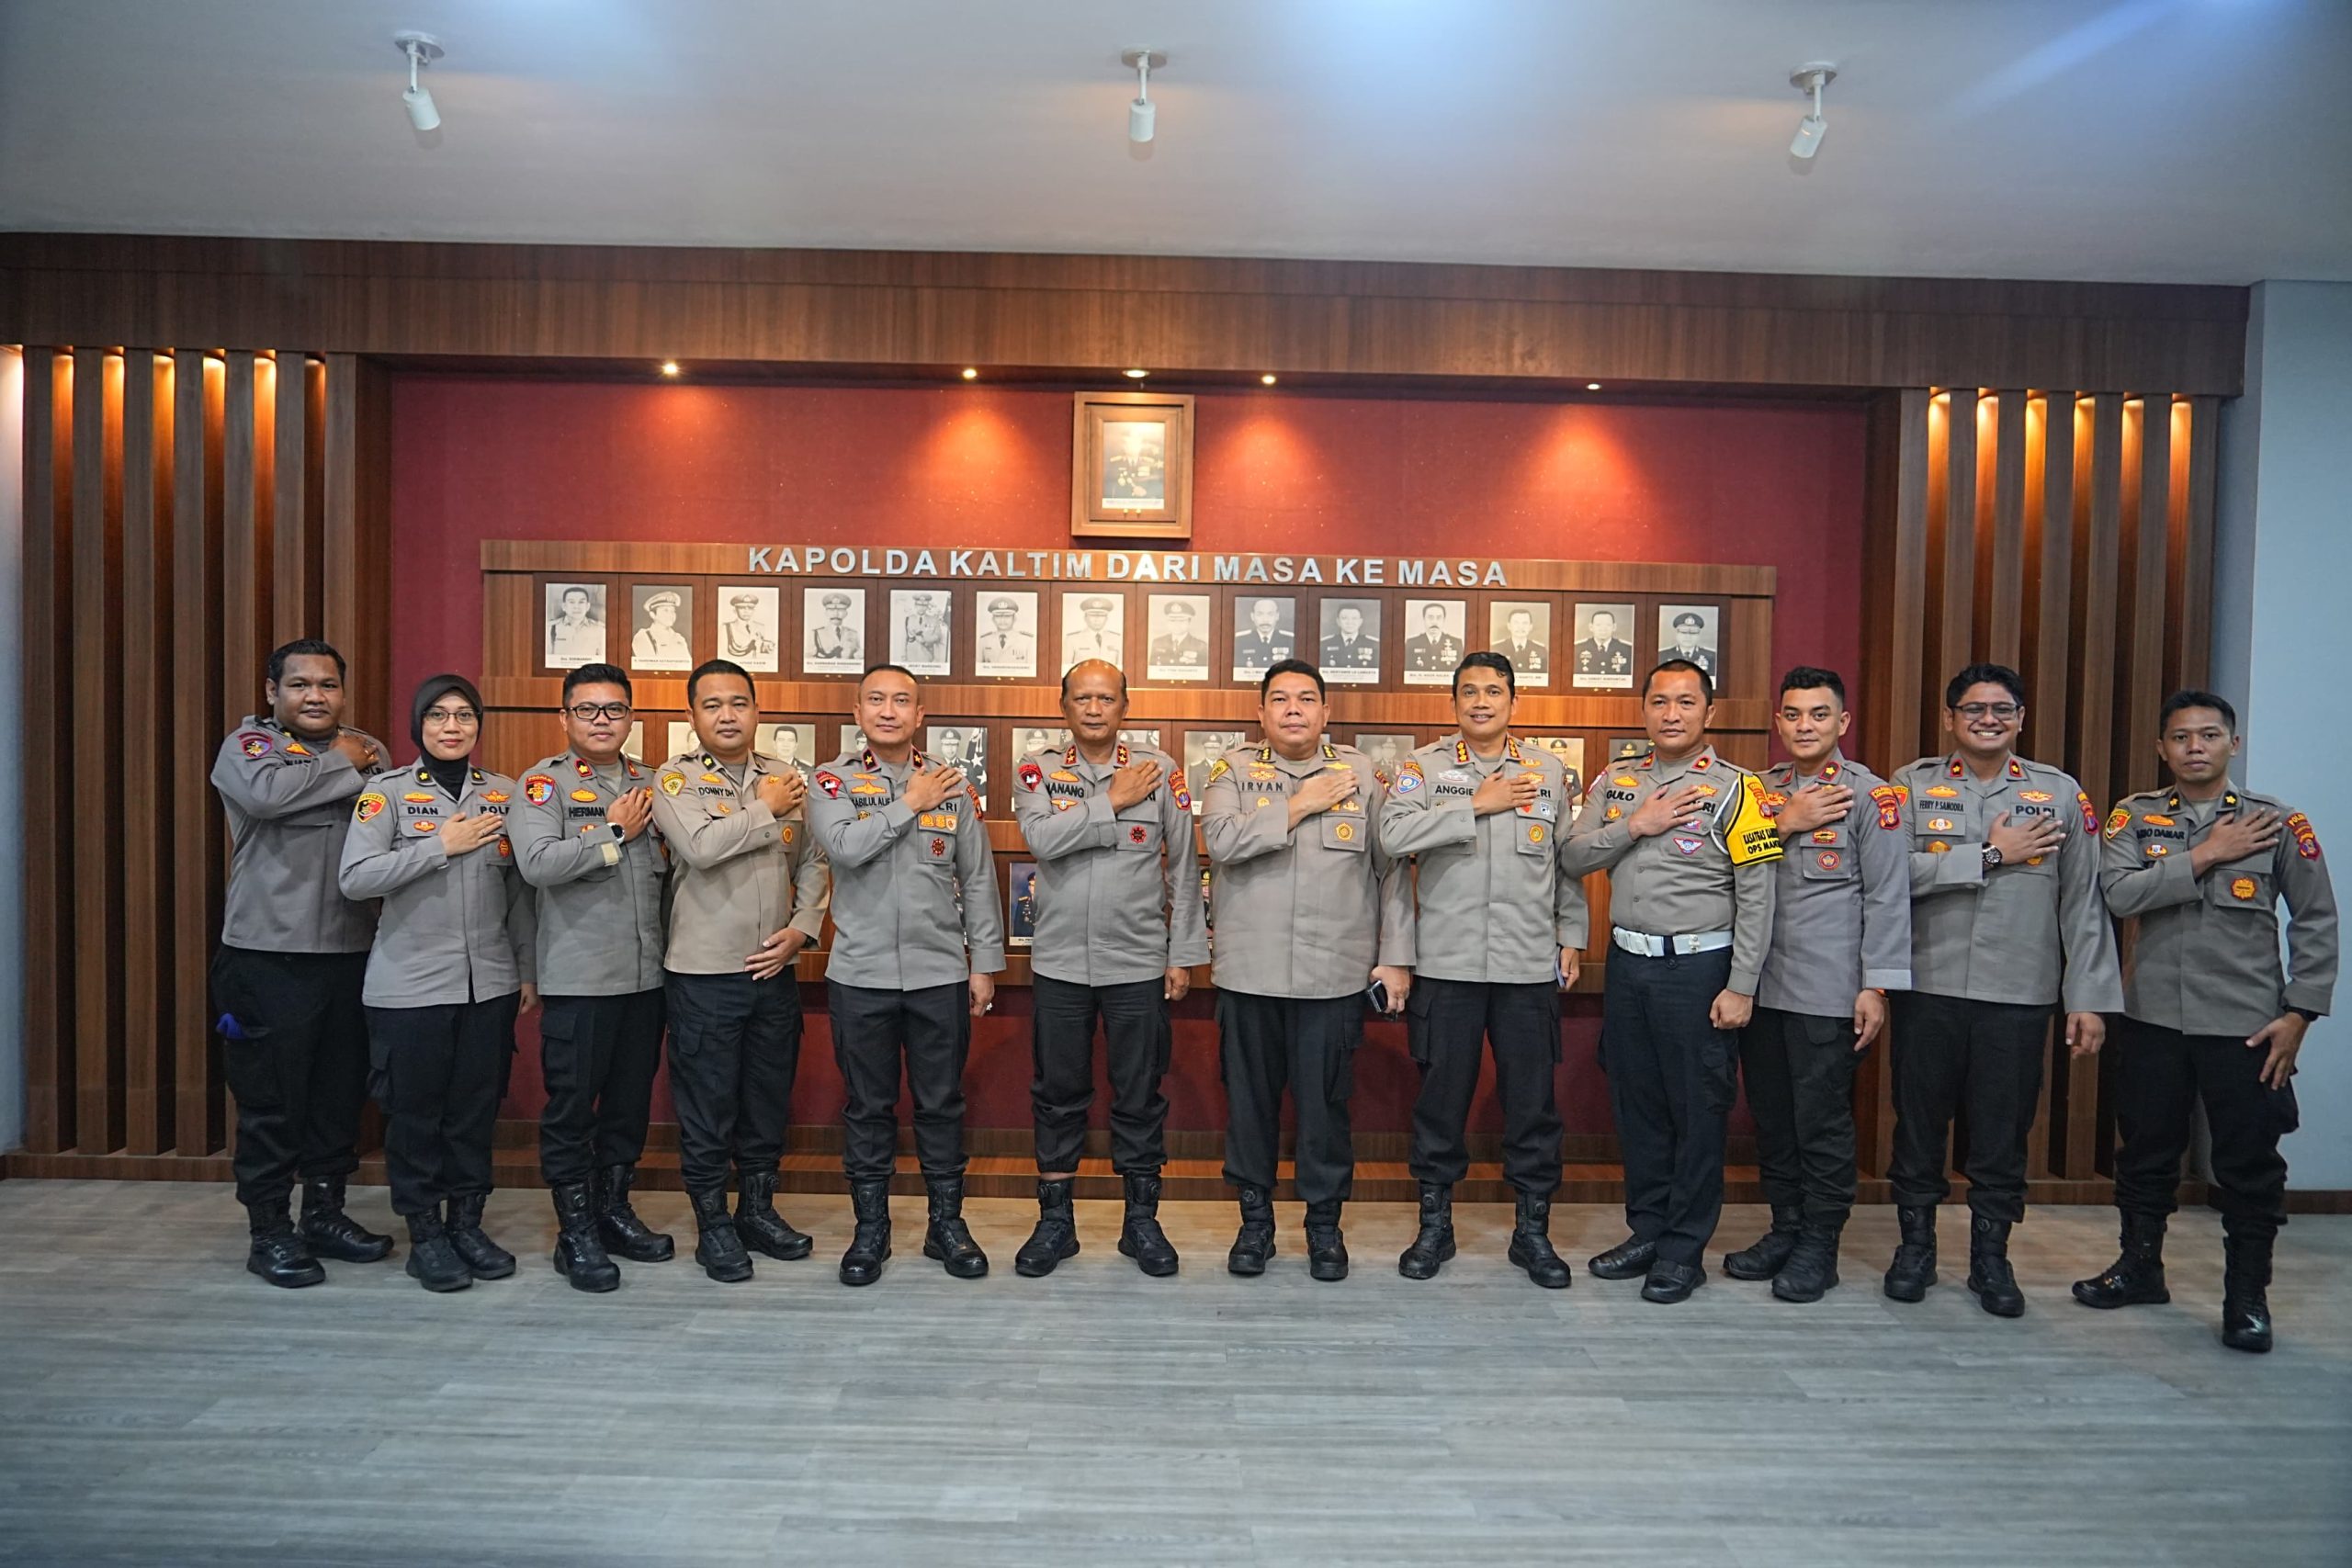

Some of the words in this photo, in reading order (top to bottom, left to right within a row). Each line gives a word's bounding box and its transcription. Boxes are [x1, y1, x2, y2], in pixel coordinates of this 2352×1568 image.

[748, 547, 938, 577] KAPOLDA
[950, 550, 1092, 579] KALTIM
[1107, 553, 1199, 581] DARI
[1214, 555, 1323, 583] MASA
[1336, 558, 1384, 585] KE
[1398, 559, 1508, 587] MASA
[698, 786, 723, 796] DONNY
[1241, 782, 1283, 792] IRVAN
[1435, 784, 1475, 796] ANGGIE
[1606, 790, 1634, 801] GULO
[407, 807, 439, 816] DIAN
[480, 806, 510, 816] POL
[569, 807, 605, 818] HERMAN
[1747, 843, 1762, 854] OPS
